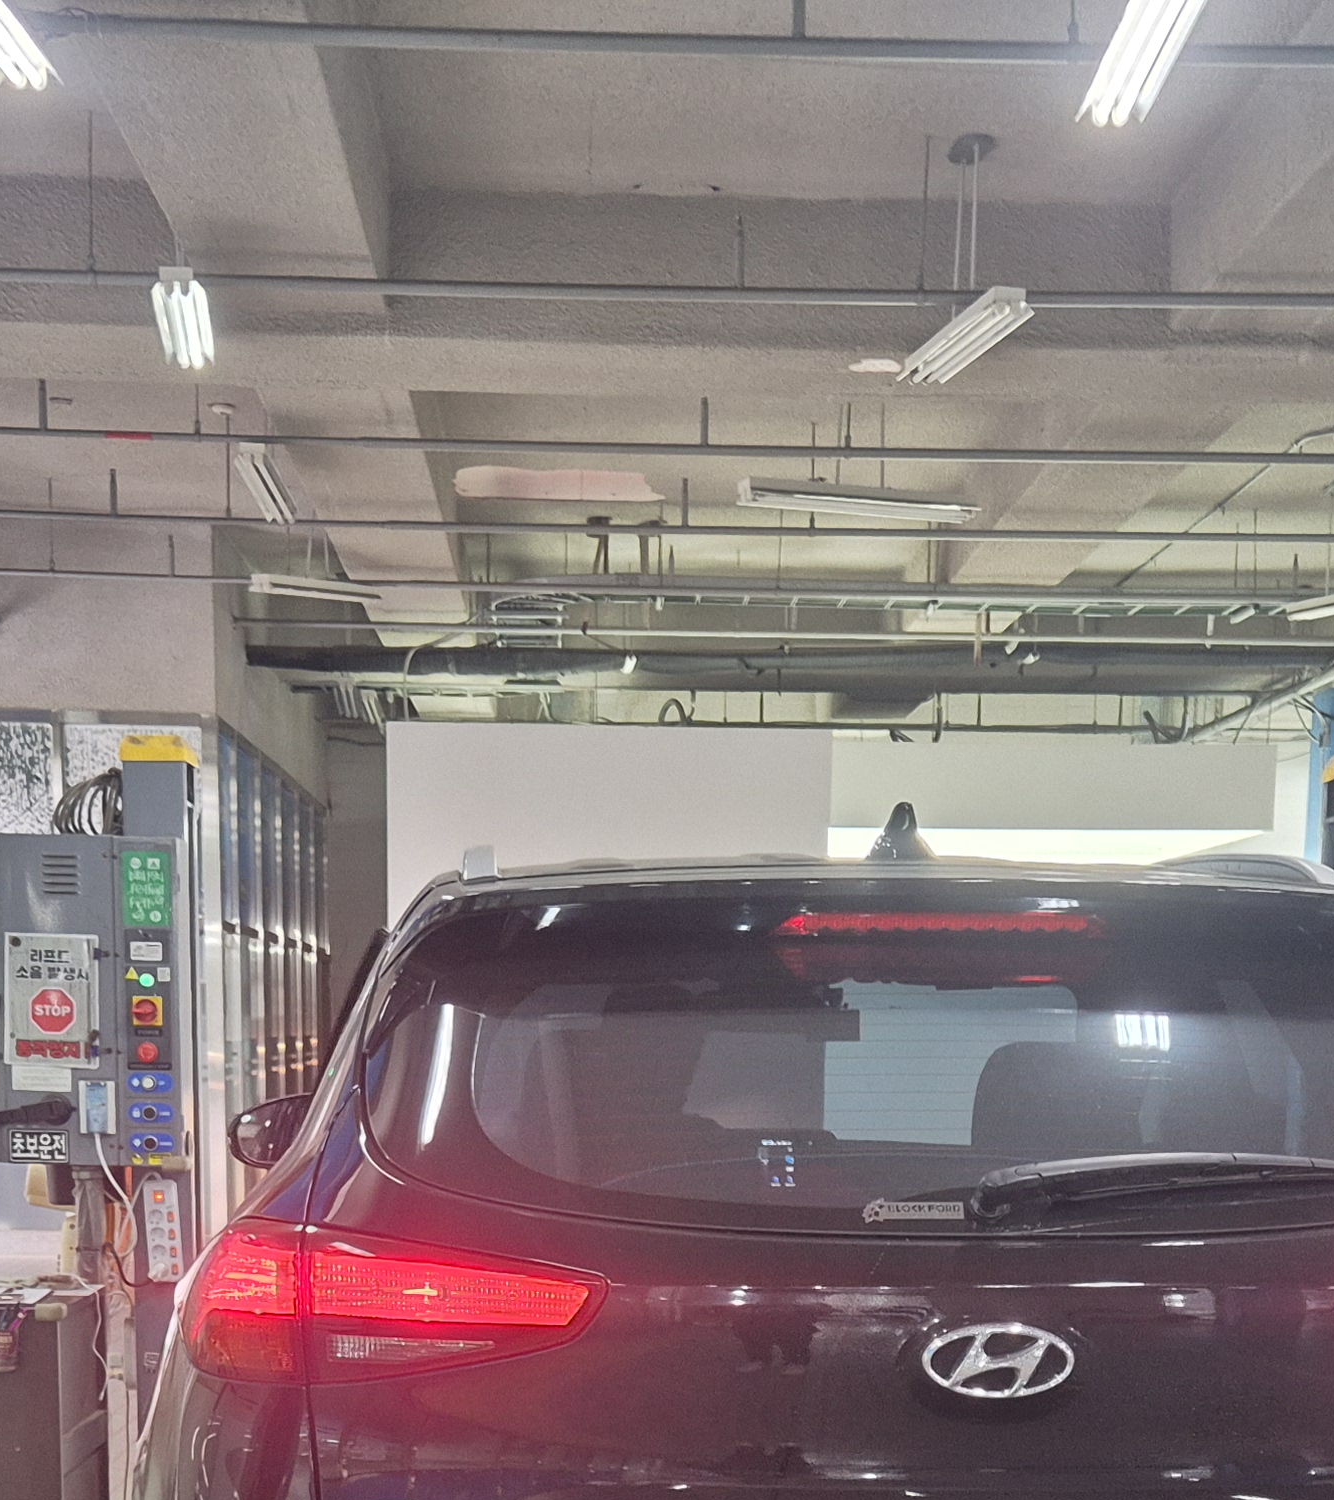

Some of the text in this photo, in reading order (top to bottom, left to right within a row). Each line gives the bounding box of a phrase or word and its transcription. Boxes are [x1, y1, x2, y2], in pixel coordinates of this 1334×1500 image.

[15, 966, 43, 979] 소음
[34, 1005, 71, 1017] STOP
[11, 1132, 67, 1160] 초보운전
